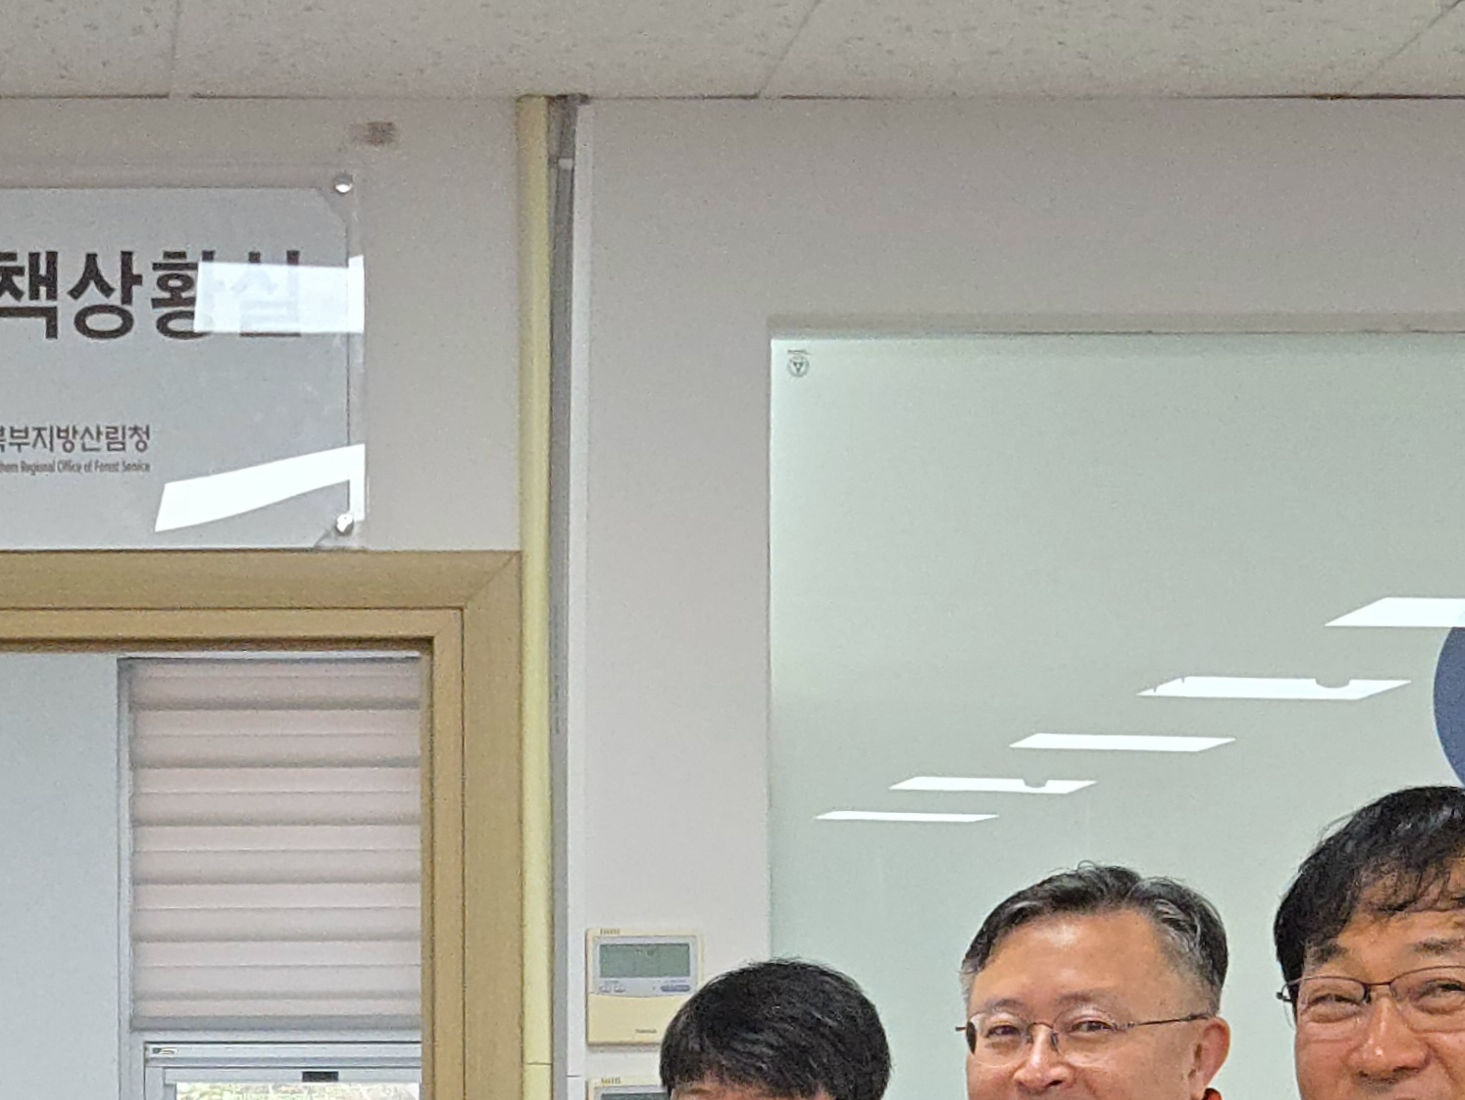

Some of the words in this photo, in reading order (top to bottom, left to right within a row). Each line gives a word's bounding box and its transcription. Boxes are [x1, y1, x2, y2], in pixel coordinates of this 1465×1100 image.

[20, 459, 56, 476] Regional
[57, 459, 82, 473] Office
[84, 458, 93, 473] of
[94, 459, 120, 473] Forest
[122, 458, 151, 473] Service
